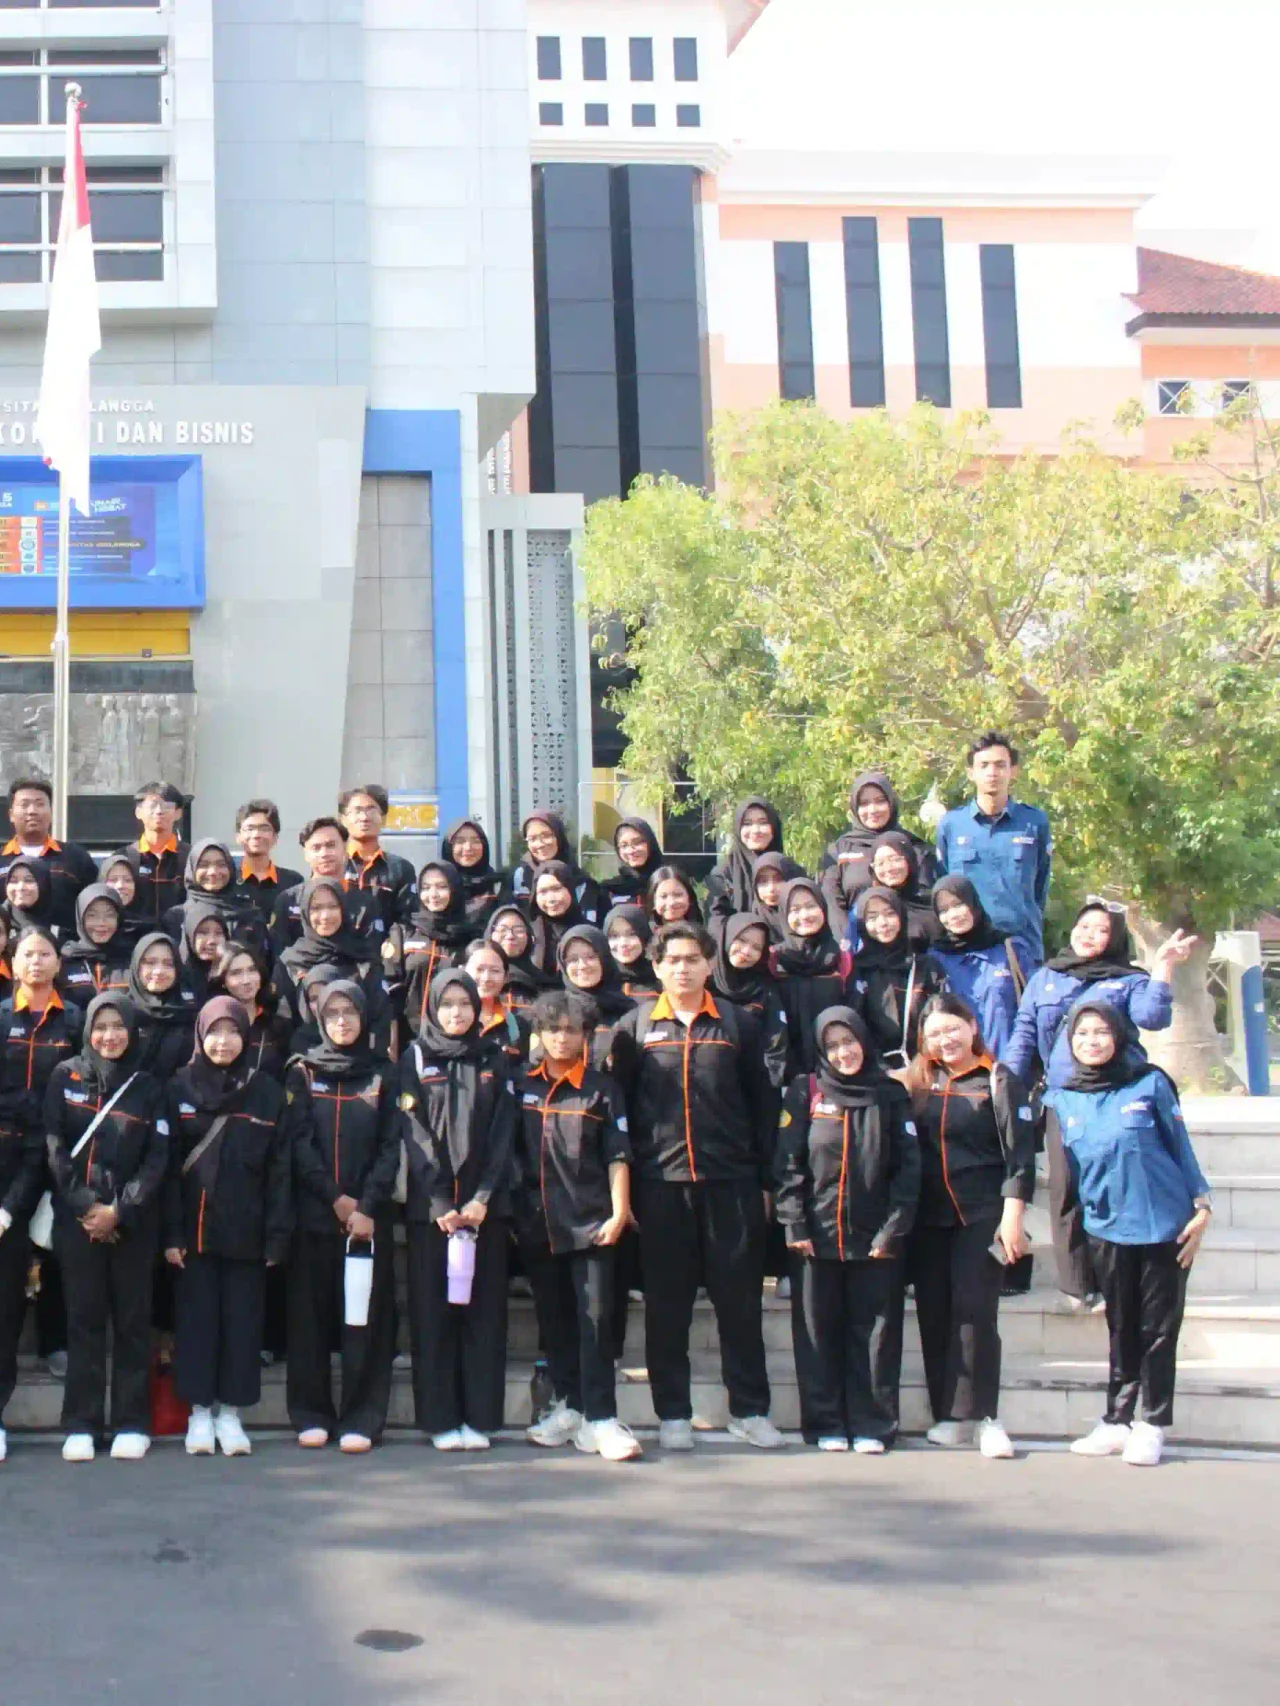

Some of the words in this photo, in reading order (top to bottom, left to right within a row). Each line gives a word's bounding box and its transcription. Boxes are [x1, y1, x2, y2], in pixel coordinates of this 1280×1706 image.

[89, 400, 155, 413] LANGGA
[116, 420, 164, 444] DAN
[175, 420, 254, 444] BISNIS
